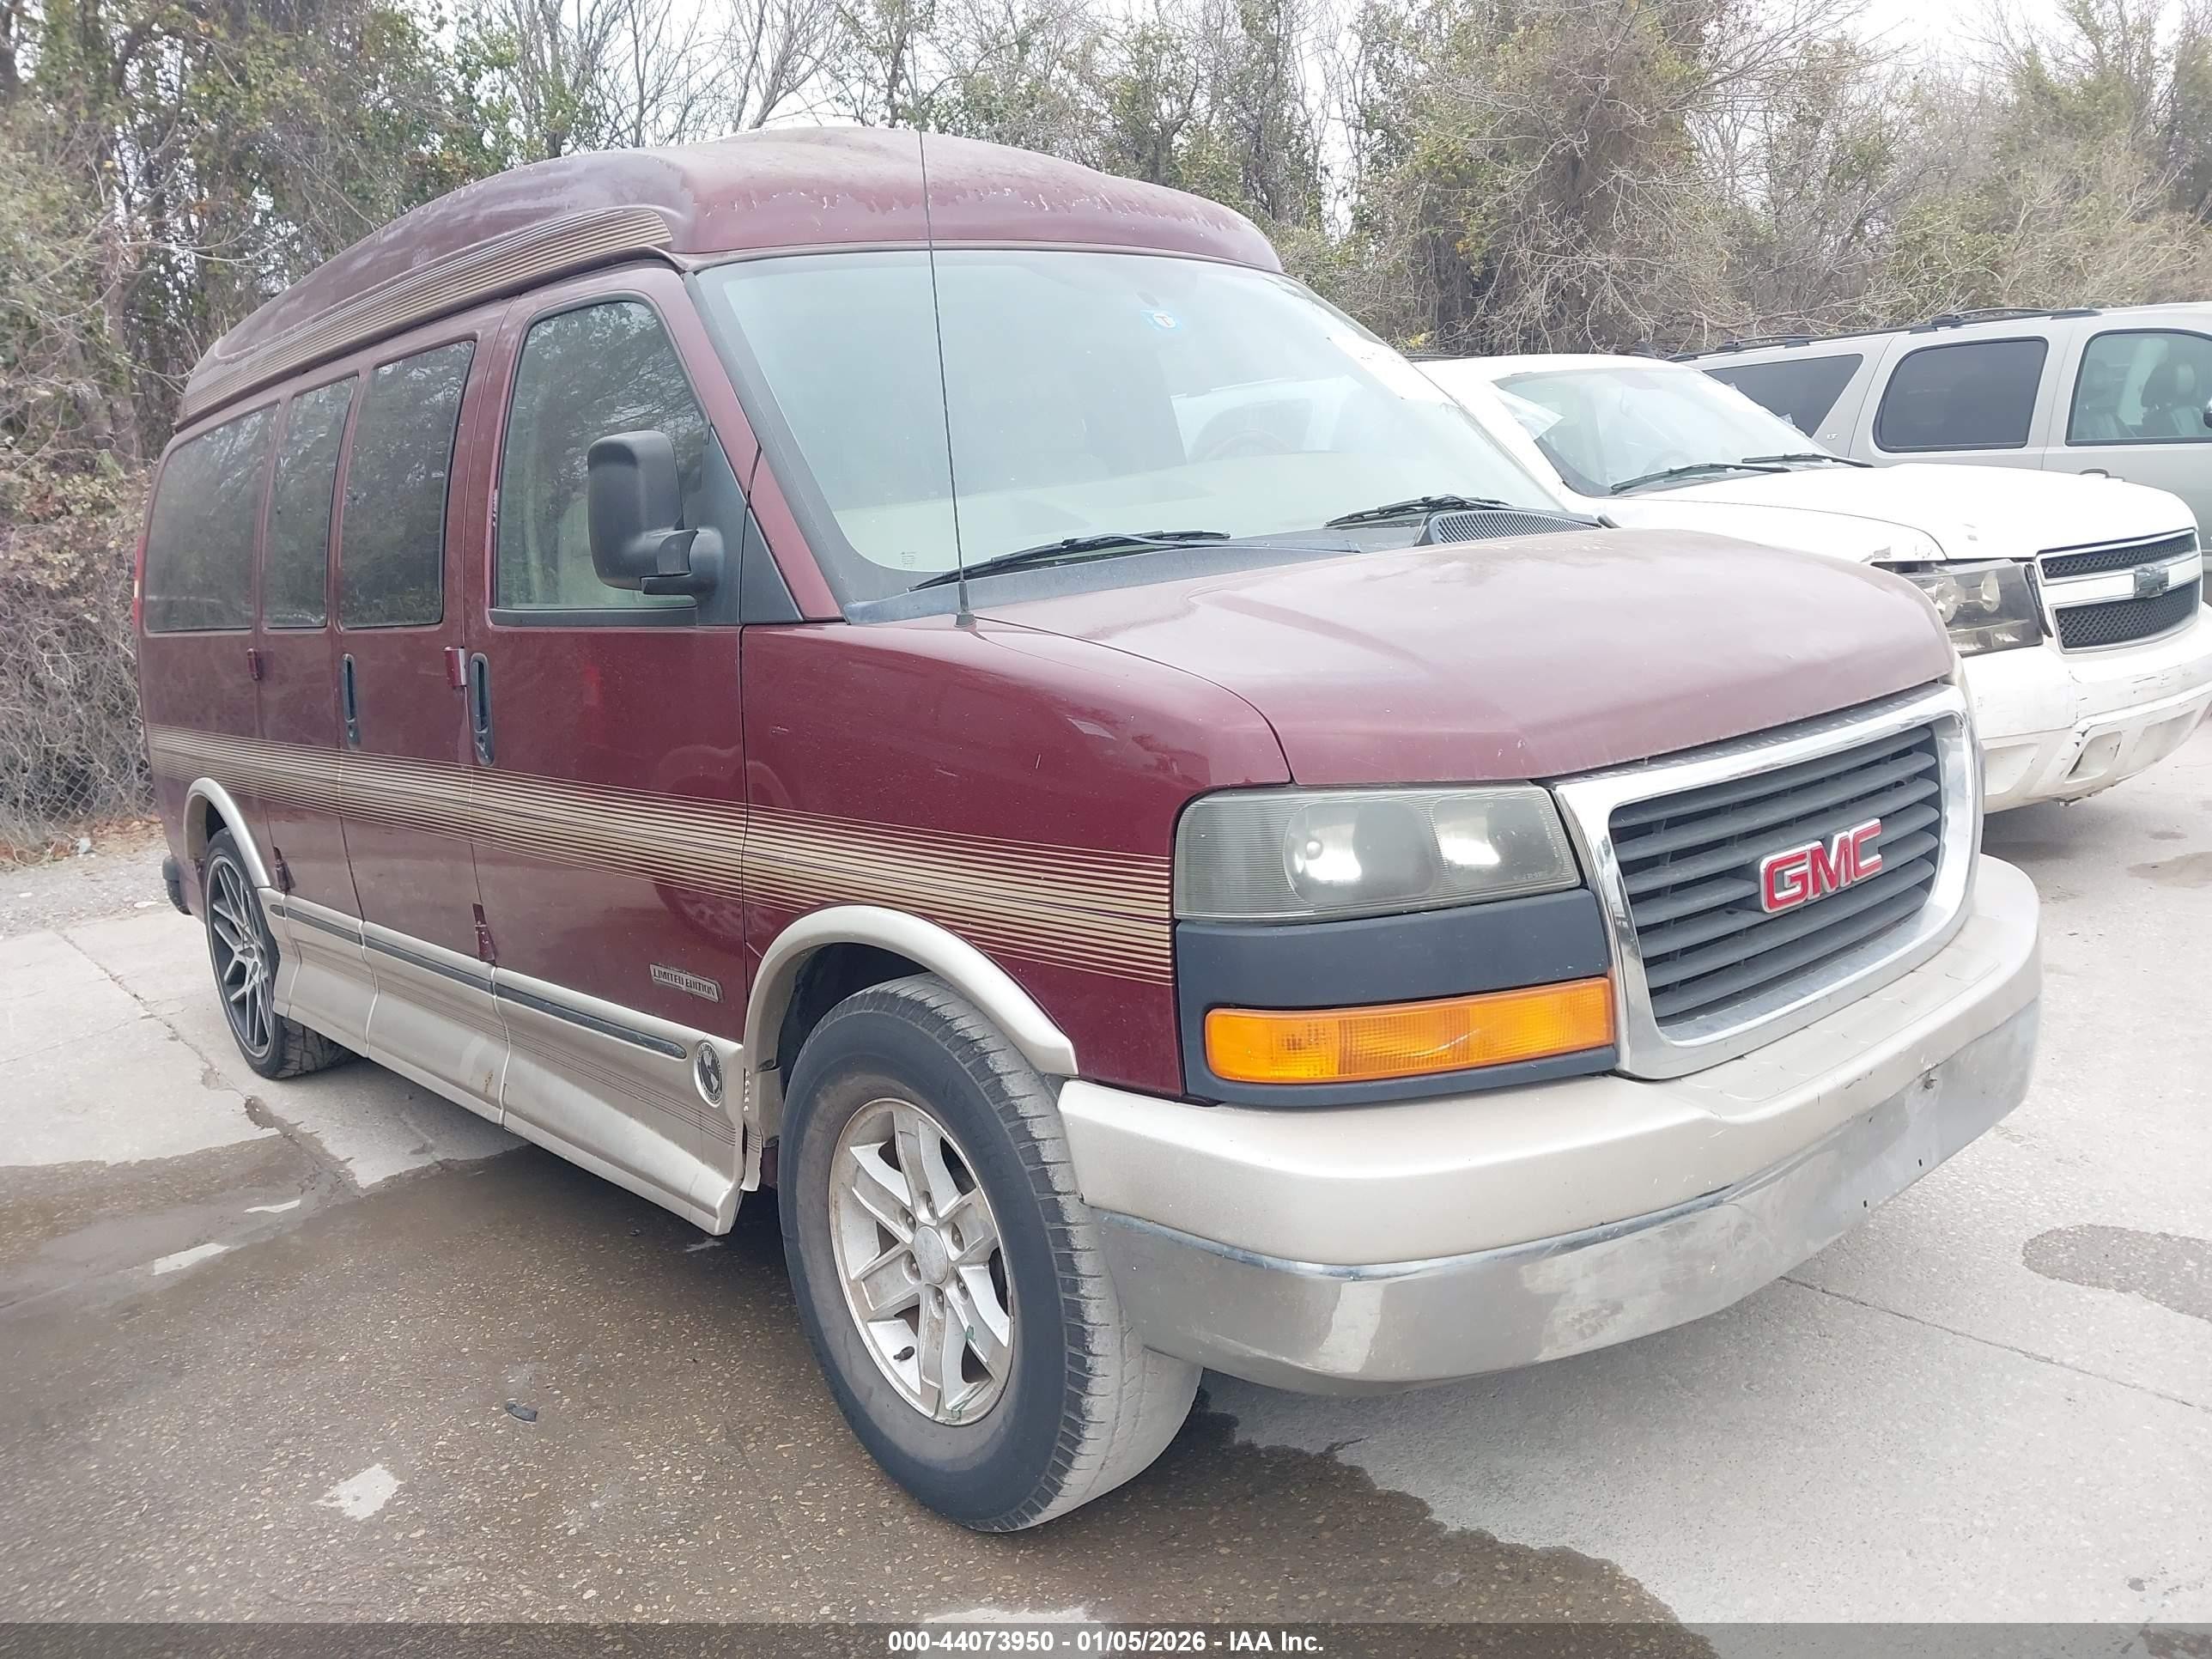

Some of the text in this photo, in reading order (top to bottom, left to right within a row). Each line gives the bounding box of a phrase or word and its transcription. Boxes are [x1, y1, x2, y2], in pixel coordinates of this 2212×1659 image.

[1760, 817, 1882, 913] GMC
[653, 968, 715, 997] LIMITED EDITION
